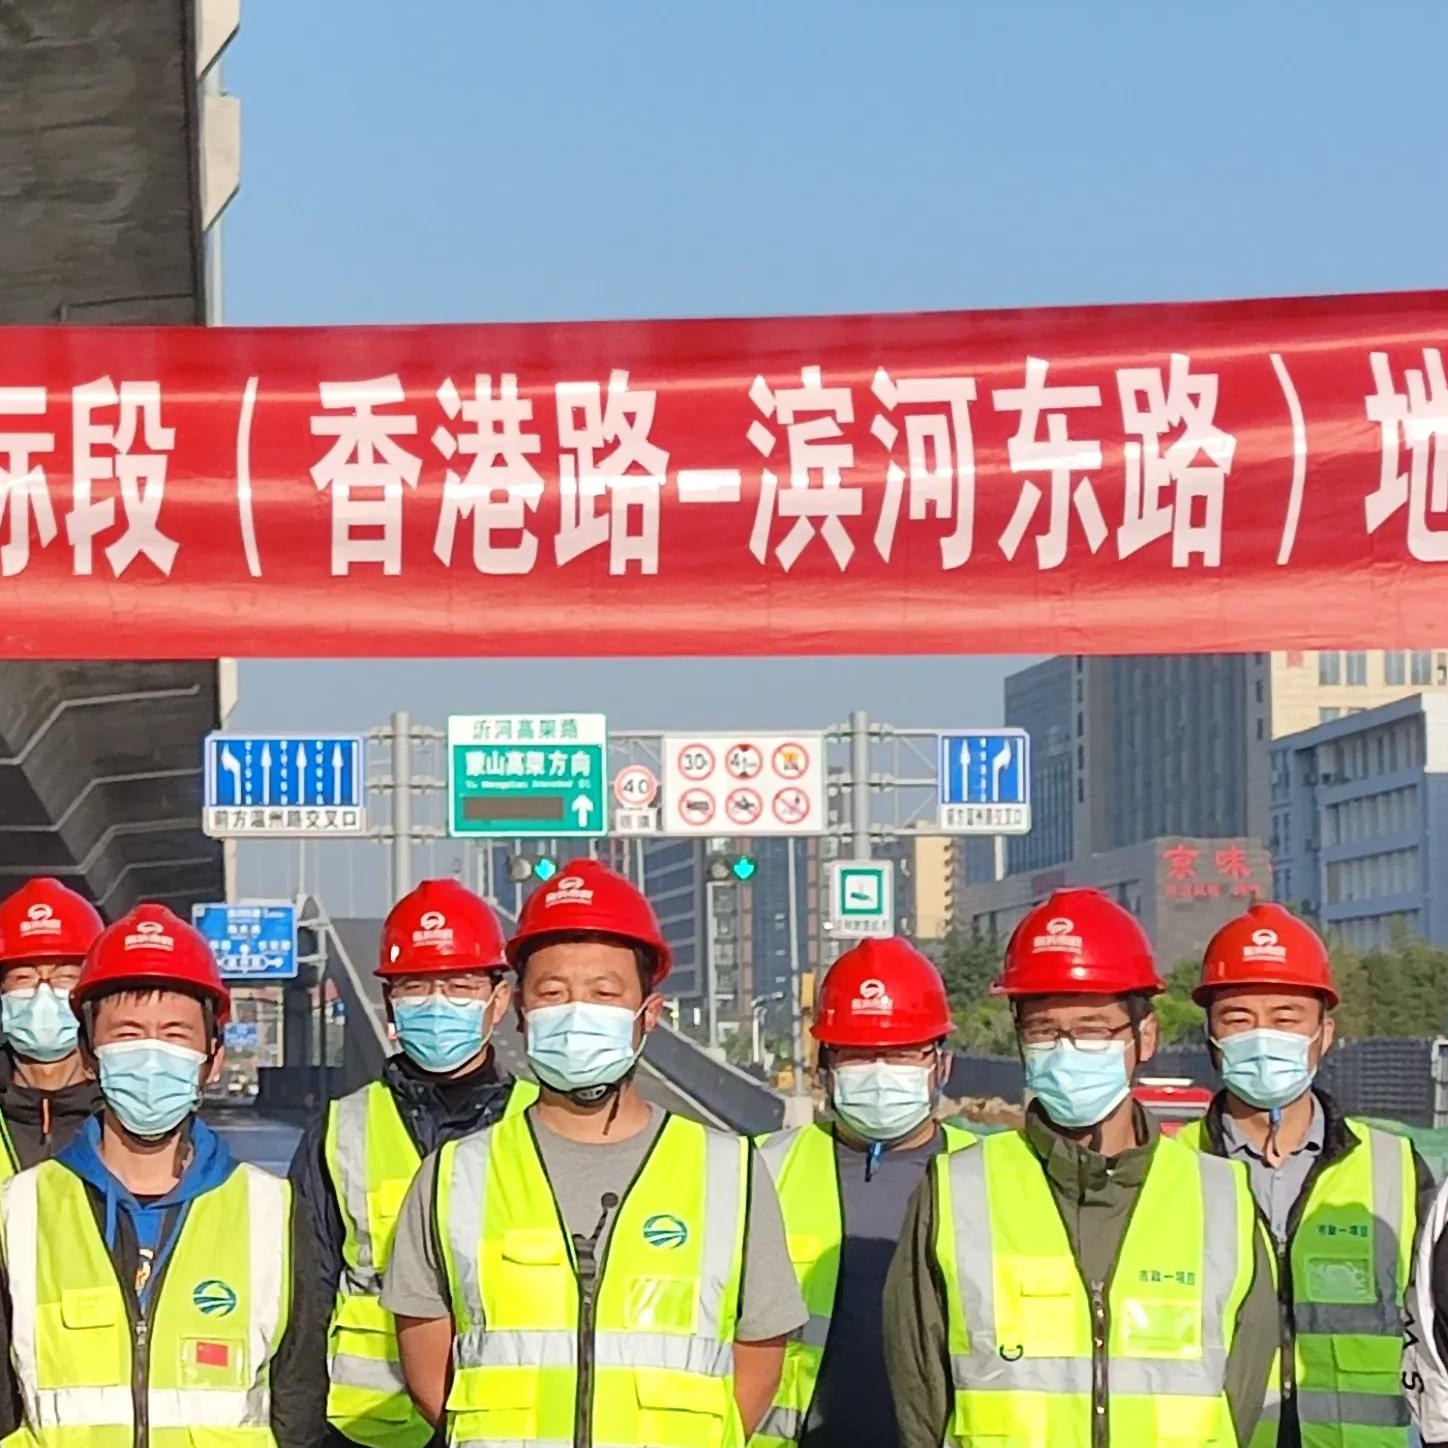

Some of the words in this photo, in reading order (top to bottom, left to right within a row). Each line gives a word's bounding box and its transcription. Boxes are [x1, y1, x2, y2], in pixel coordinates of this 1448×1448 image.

[472, 718, 578, 740] 沂河高架路
[623, 778, 649, 794] 40
